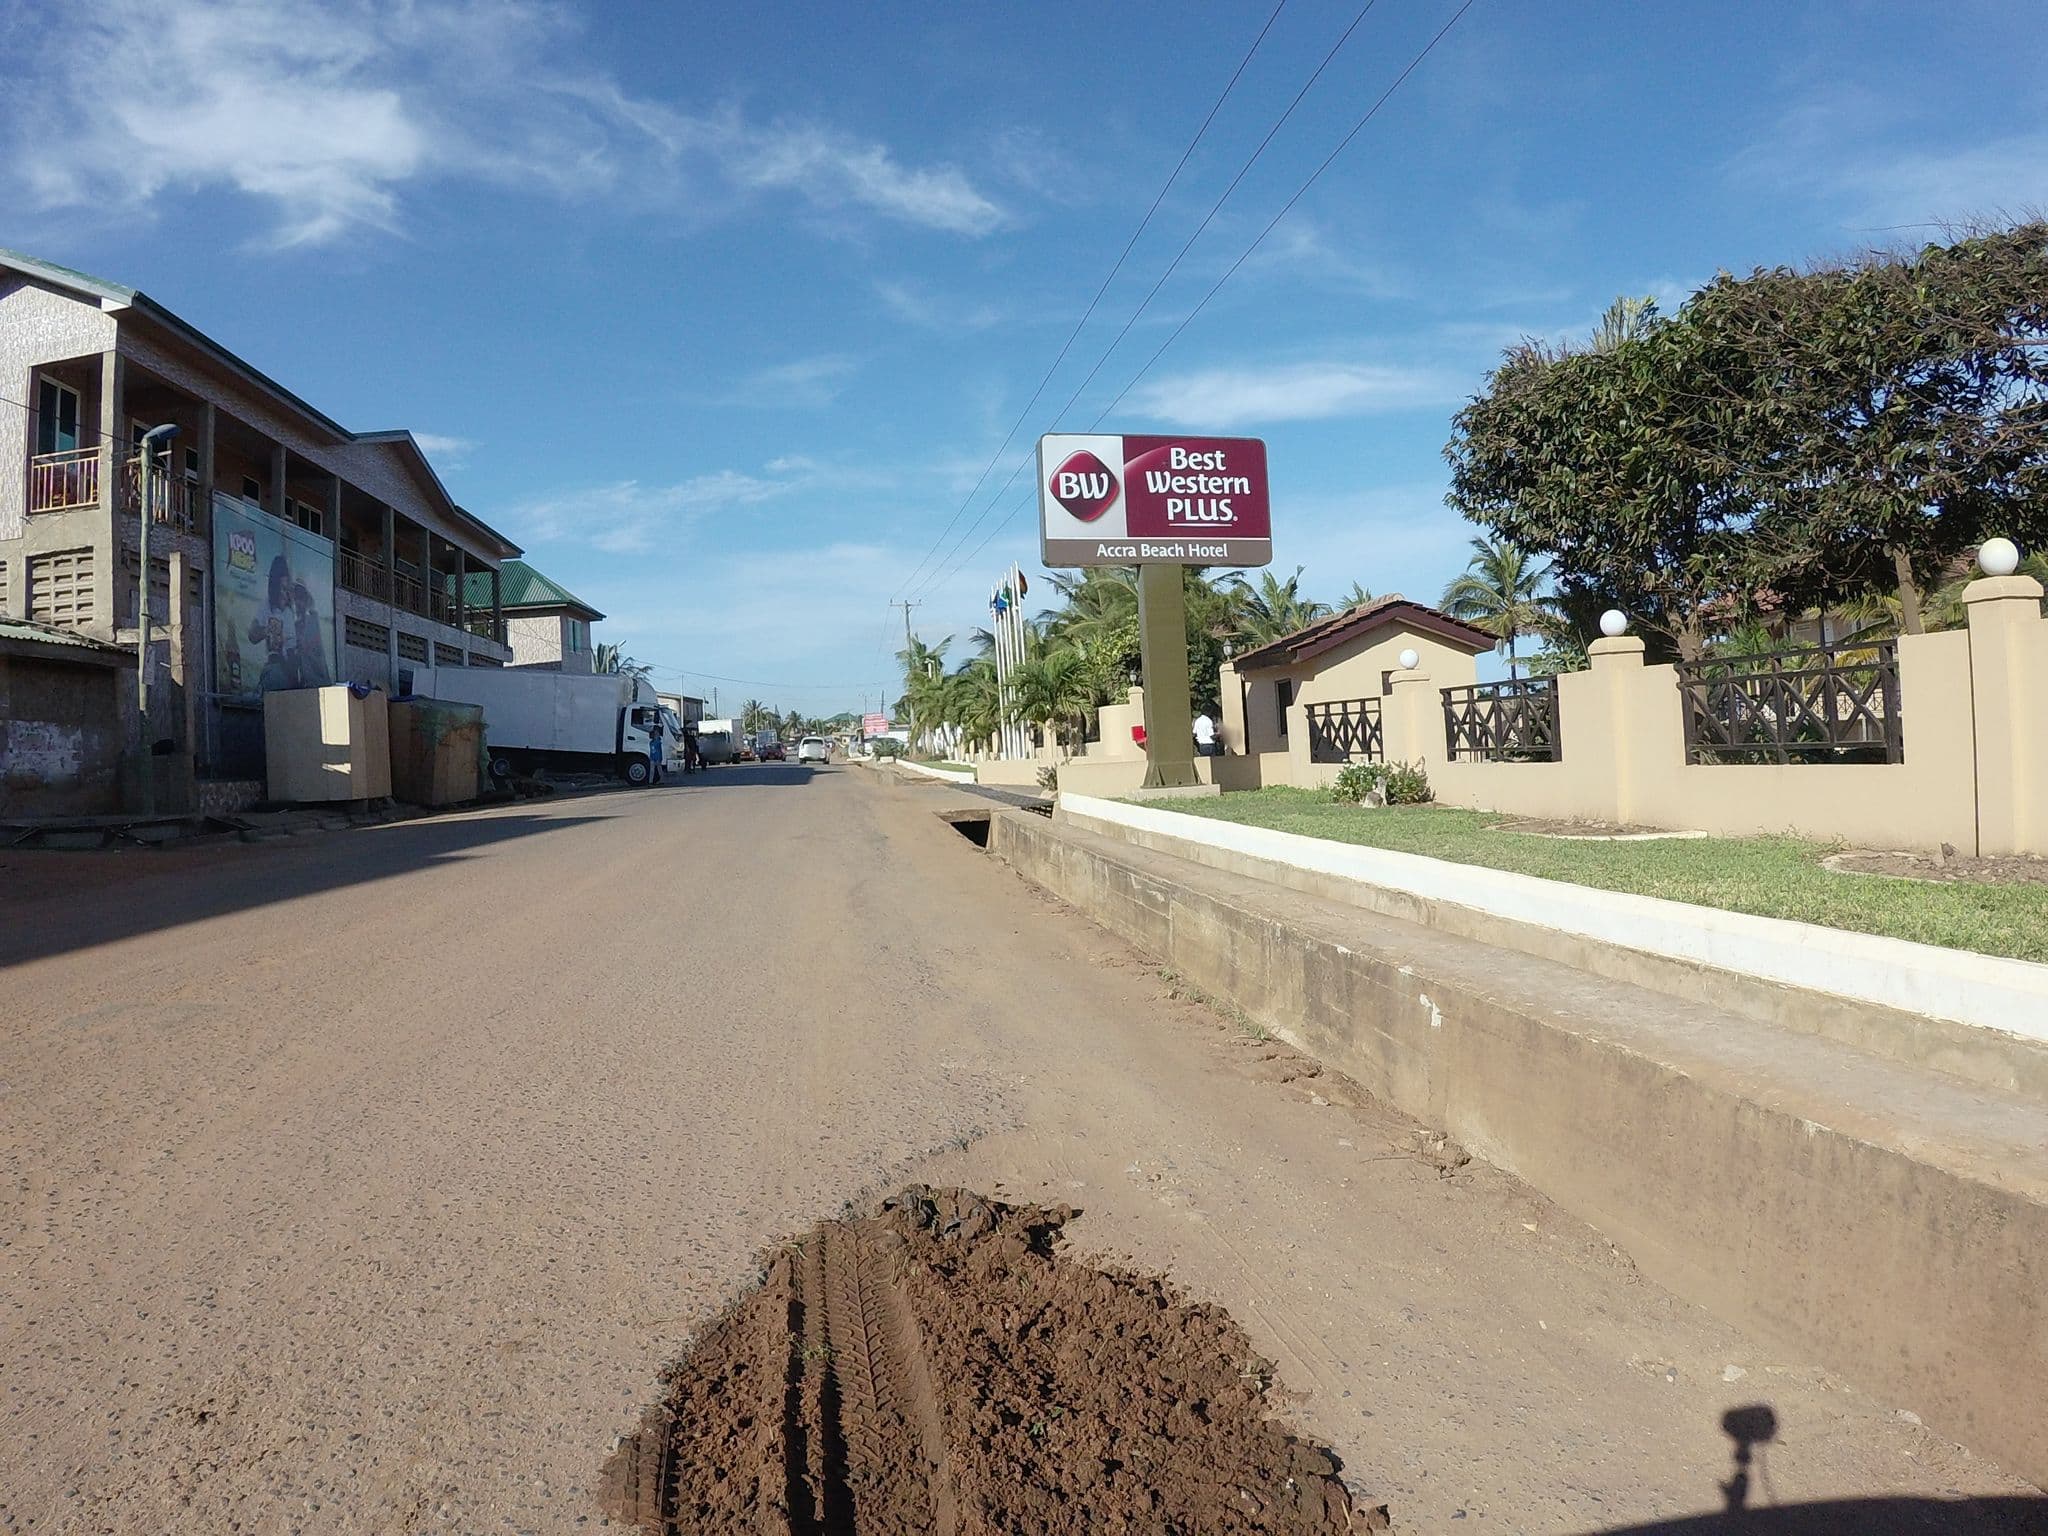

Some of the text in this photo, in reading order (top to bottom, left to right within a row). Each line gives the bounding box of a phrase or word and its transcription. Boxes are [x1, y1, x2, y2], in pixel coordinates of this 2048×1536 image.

[1170, 447, 1226, 471] Best
[1058, 472, 1109, 500] BW
[1145, 471, 1251, 494] Western
[1096, 543, 1228, 558] Accra Beach Hotel
